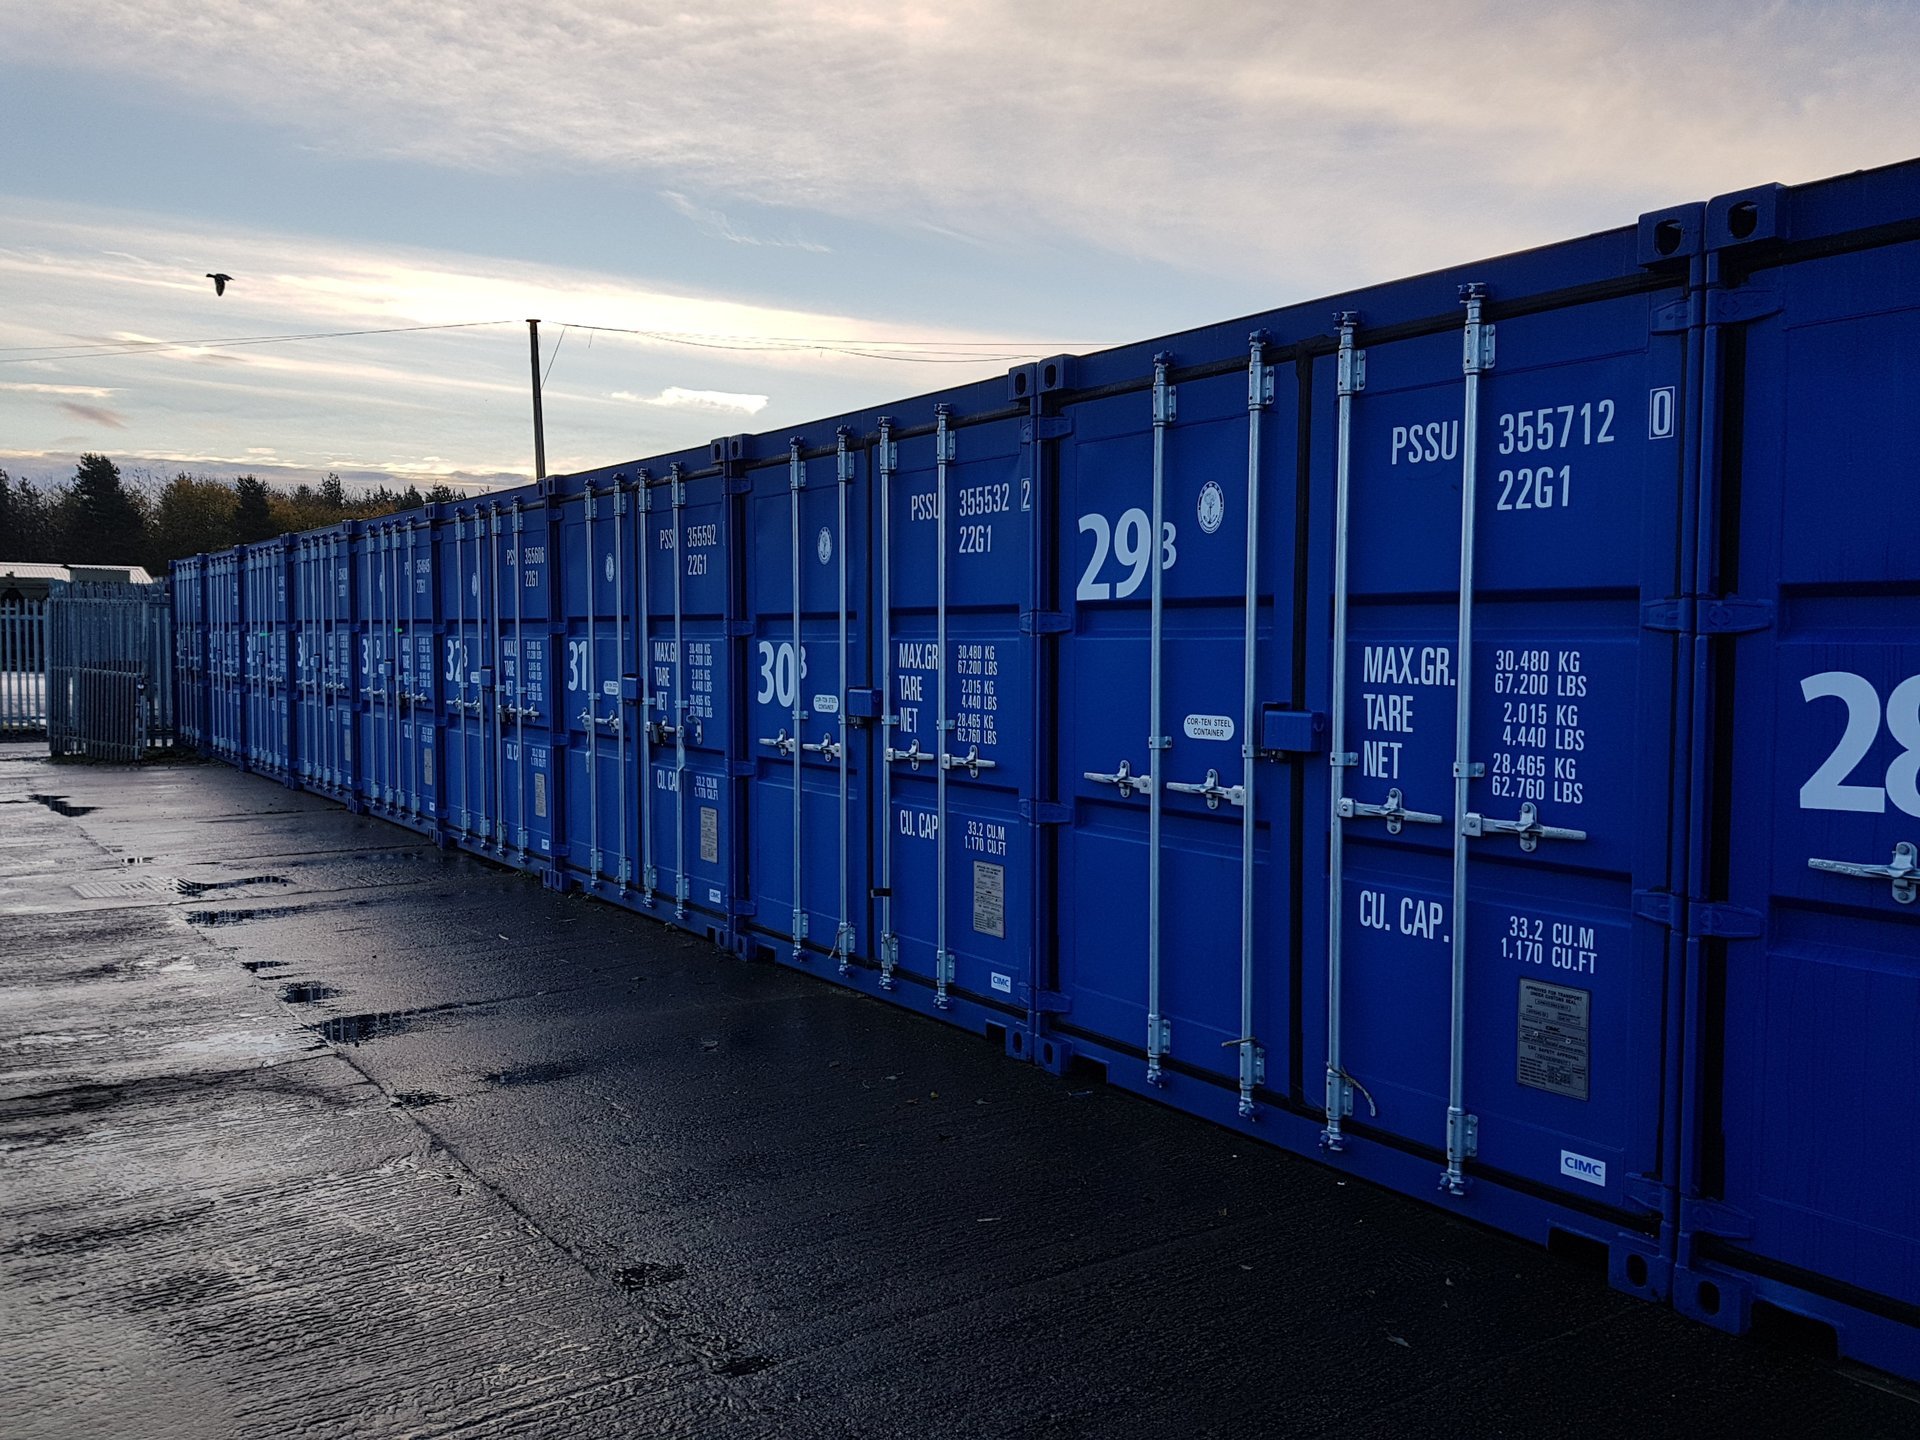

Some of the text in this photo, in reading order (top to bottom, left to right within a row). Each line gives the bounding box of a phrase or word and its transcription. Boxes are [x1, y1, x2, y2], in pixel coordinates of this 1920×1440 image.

[1391, 388, 1673, 465] PSSU 355712 0
[1496, 465, 1571, 511] 22G1
[959, 483, 1010, 517] 355532
[687, 524, 717, 548] 355592
[958, 525, 992, 553] 22G1
[687, 554, 707, 575] 22G1
[984, 645, 995, 660] KG
[1558, 651, 1580, 673] KG
[984, 661, 998, 676] LBS
[1363, 646, 1456, 686] MAX.GR.
[899, 675, 923, 702] TARE
[984, 680, 994, 695] KG
[1557, 674, 1587, 697] LBS
[983, 696, 997, 711] LBS
[1363, 693, 1414, 733] TARE
[900, 707, 919, 733] NET
[983, 714, 994, 730] KG
[1213, 719, 1231, 728] STEEL
[1556, 704, 1578, 727] KG
[983, 730, 997, 745] LBS
[1193, 727, 1224, 737] CONTAINER
[1555, 728, 1585, 751] LBS
[1363, 741, 1403, 779] NET
[1554, 757, 1576, 780] KG
[1554, 780, 1583, 804] LBS
[900, 809, 915, 837] CU.
[967, 820, 1005, 841] 33.2 CU.M
[987, 839, 1007, 856] CU.FT
[1359, 889, 1450, 943] CU. CAP.
[1509, 915, 1594, 950] 33.2 CU.M
[1551, 946, 1598, 974] CU.FT
[1564, 1156, 1602, 1177] CIMC
